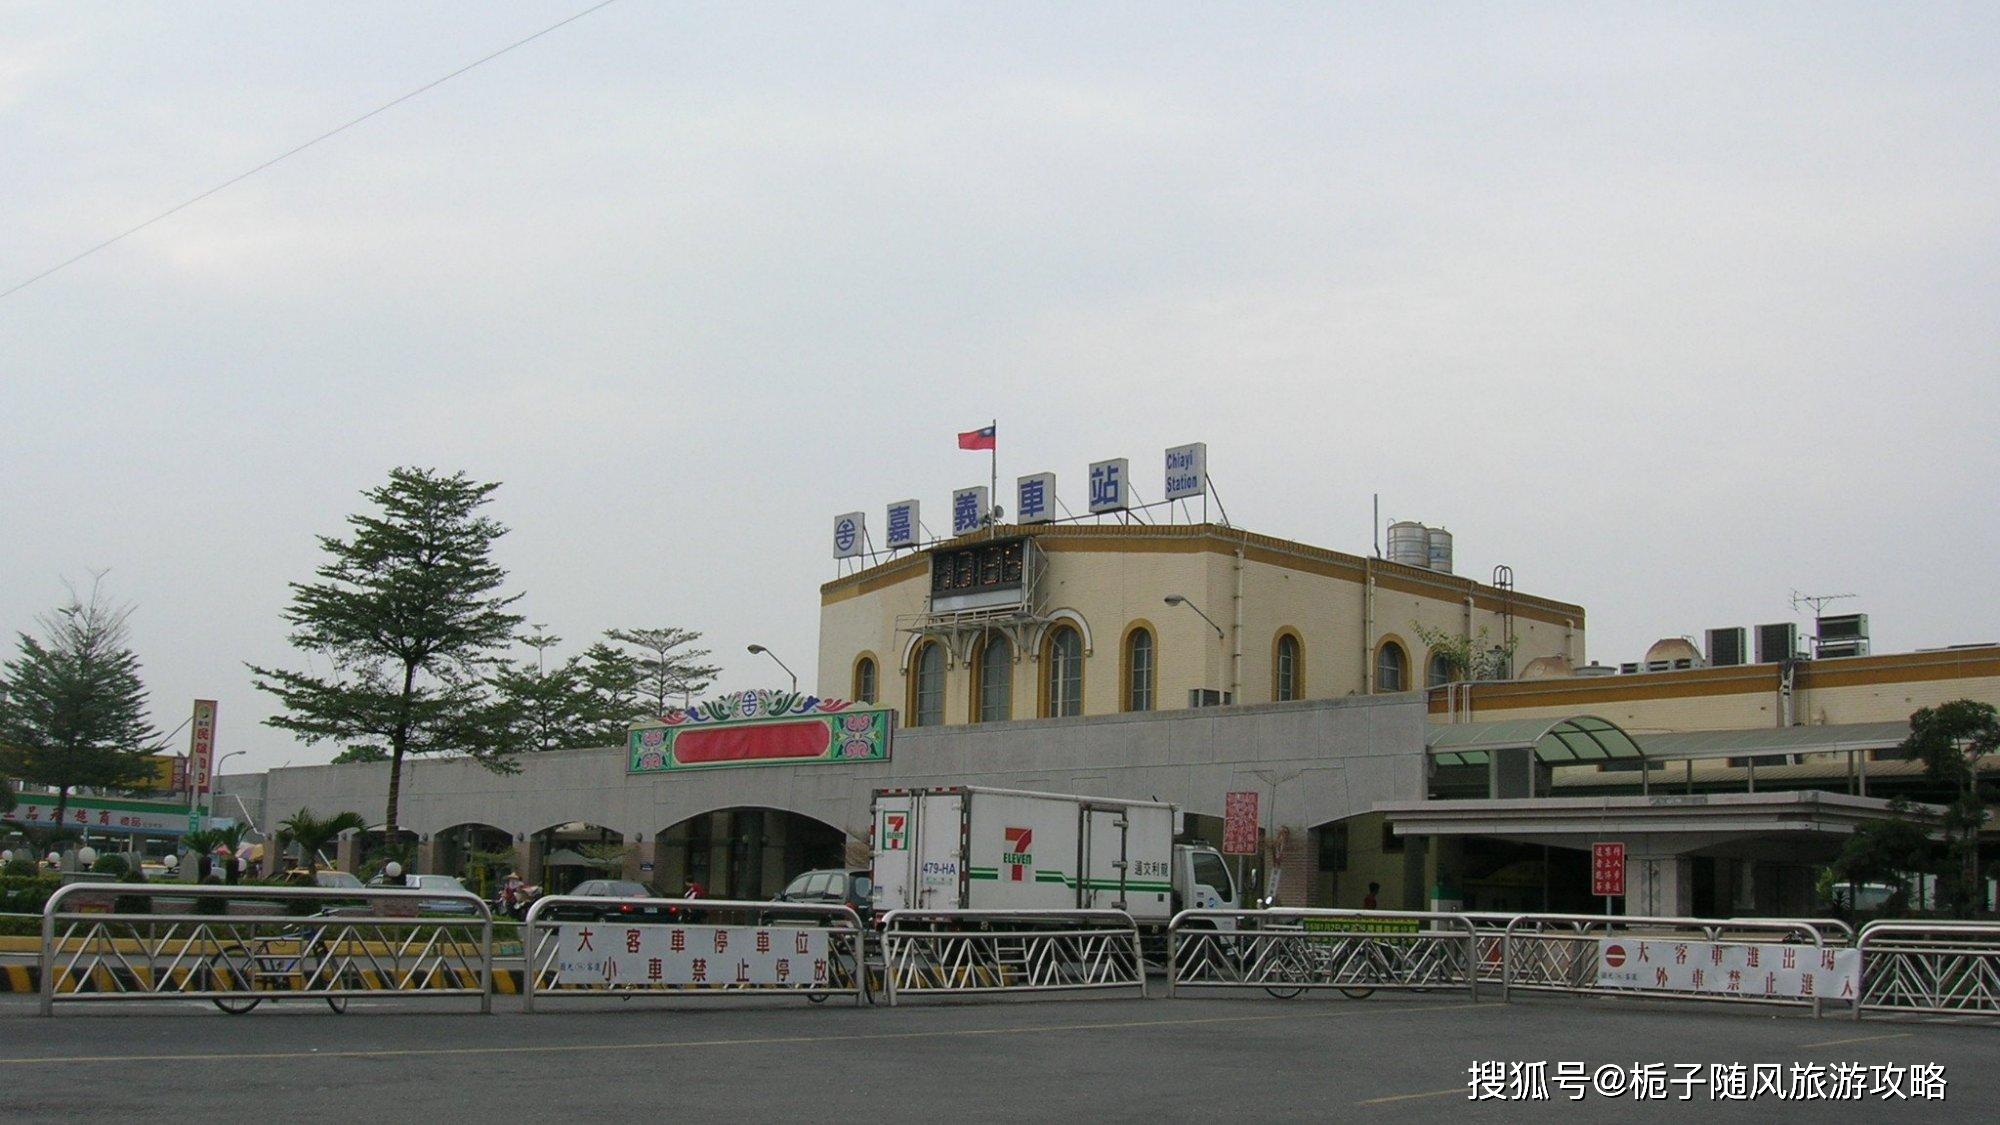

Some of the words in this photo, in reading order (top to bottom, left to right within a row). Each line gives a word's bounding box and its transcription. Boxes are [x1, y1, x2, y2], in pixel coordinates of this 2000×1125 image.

[1167, 450, 1193, 470] Chiayi
[1167, 474, 1197, 492] Station
[888, 464, 1120, 543] 嘉義車站
[923, 862, 956, 875] 479-HA
[1005, 827, 1032, 881] 7
[577, 926, 808, 955] 大客車停車位
[602, 956, 828, 982] 小車禁止停放
[1637, 941, 1836, 971] 大客車進出場
[1656, 967, 1854, 998] 外車禁止進入
